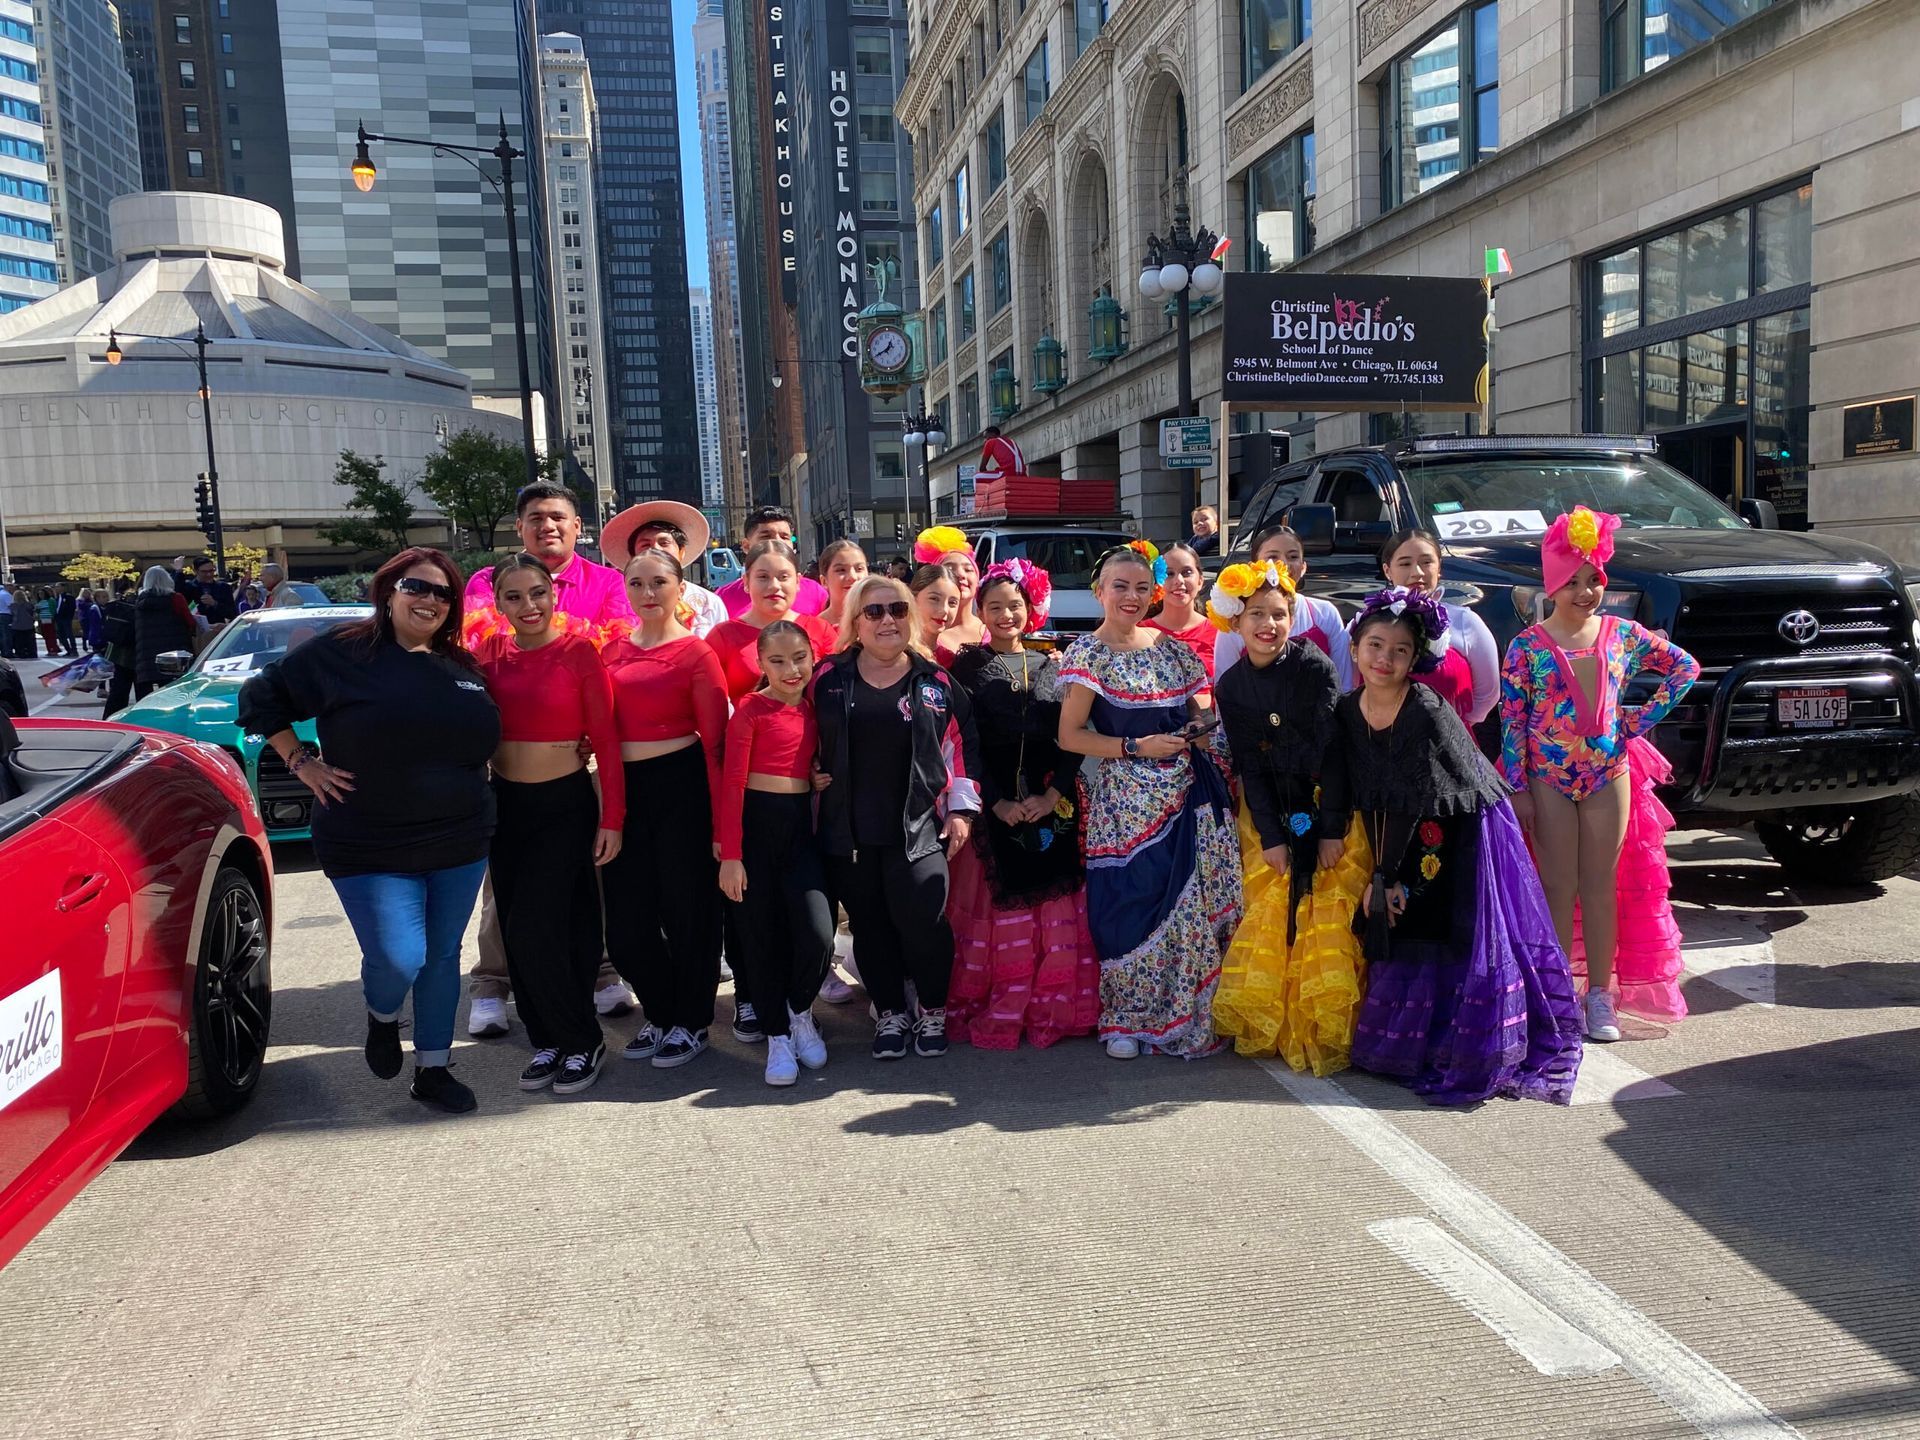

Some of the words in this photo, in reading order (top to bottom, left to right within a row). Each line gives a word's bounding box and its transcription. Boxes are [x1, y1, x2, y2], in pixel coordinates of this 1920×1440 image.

[770, 6, 796, 271] STEAKHOUSE
[830, 70, 850, 192] HOTEL
[836, 211, 859, 357] MONACO
[1270, 299, 1330, 313] Christine
[1270, 308, 1415, 354] Belpedio's
[1282, 343, 1317, 355] School
[1328, 344, 1339, 355] of
[1341, 344, 1374, 355] Dance
[1233, 358, 1257, 368] 5945
[1259, 358, 1273, 368] W.
[1276, 358, 1318, 369] Belmont
[1318, 359, 1338, 369] Ave
[1352, 359, 1394, 372] Chicago,
[1397, 360, 1408, 370] IL
[1410, 360, 1438, 371] 60634
[1226, 371, 1368, 384] ChristineBelpedioDance.com
[1383, 373, 1444, 384] 773.745.1383
[1078, 393, 1121, 430] WACKER
[1128, 372, 1167, 410] DRIVE
[0, 402, 152, 422] EENTH
[186, 402, 347, 422] CHURCH
[373, 408, 407, 426] OF
[1447, 518, 1493, 537] 29
[1499, 518, 1530, 534] A
[1793, 689, 1831, 697] ILLINOIS
[1794, 700, 1810, 719] 5A
[1814, 699, 1839, 719] 169
[0, 995, 55, 1075] rillo
[7, 1043, 60, 1091] CHICAGO
